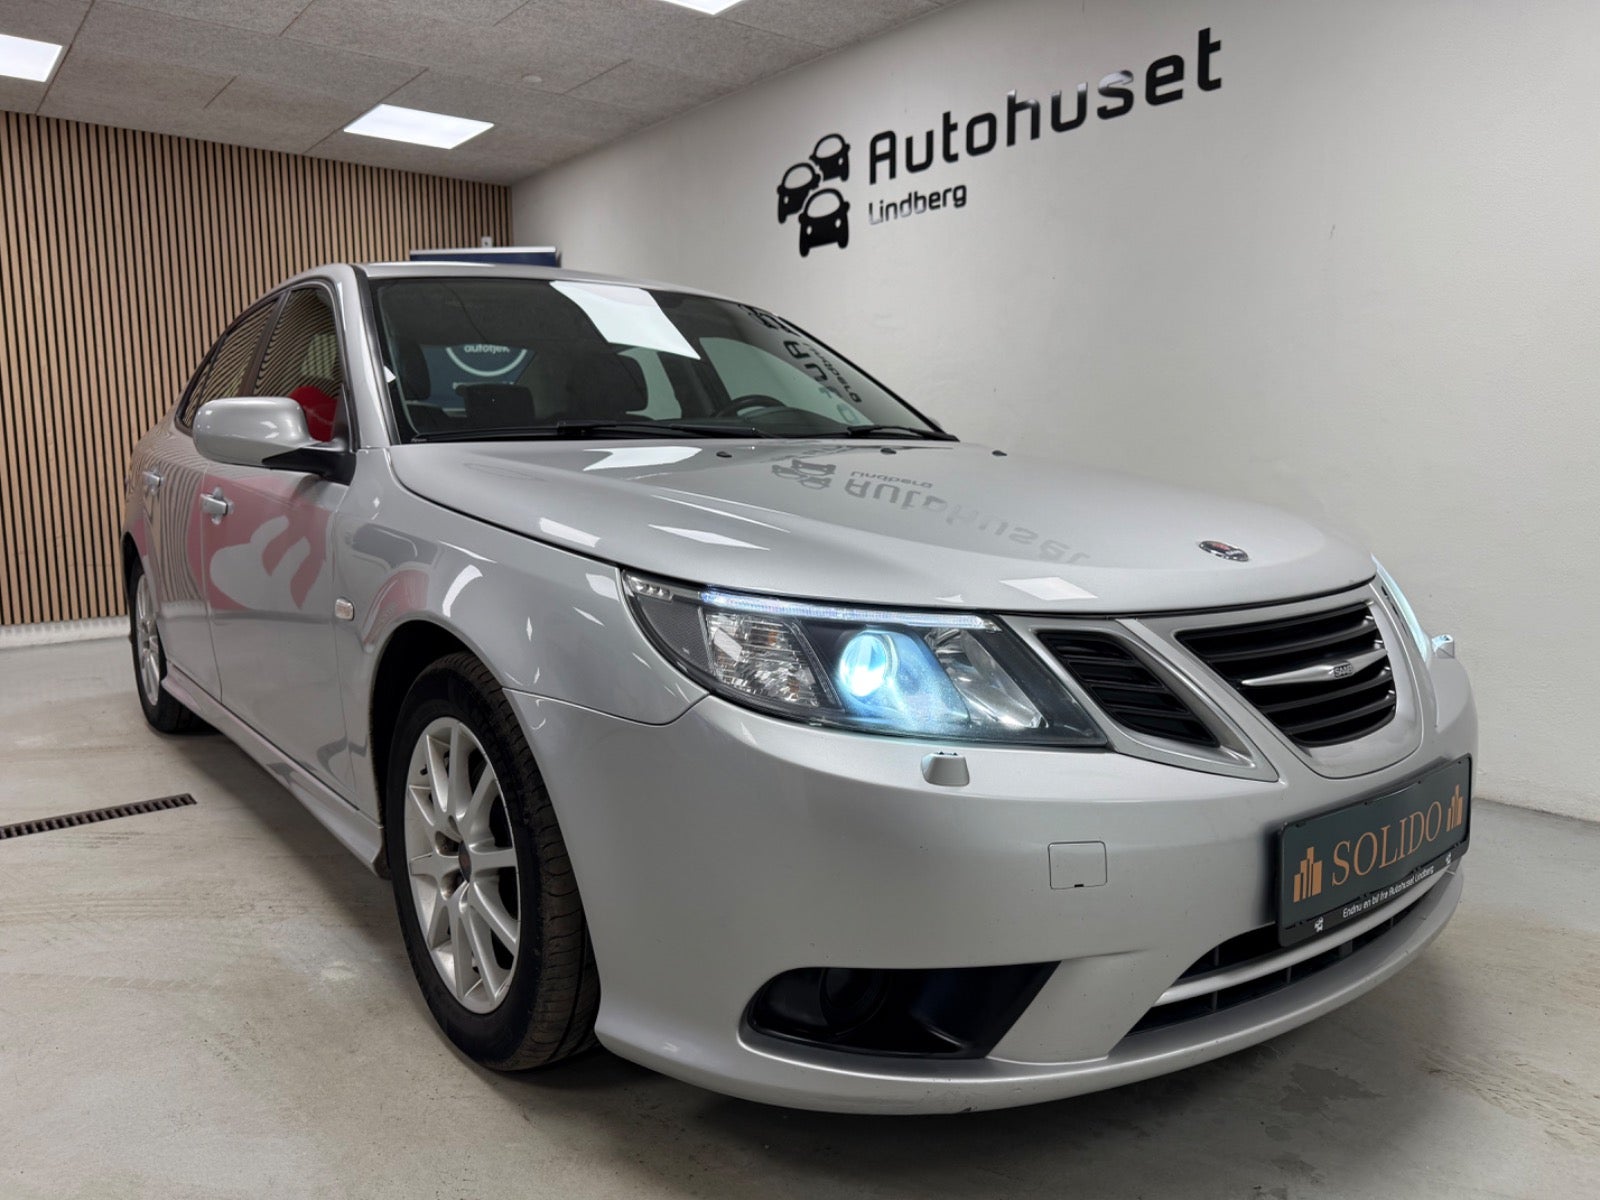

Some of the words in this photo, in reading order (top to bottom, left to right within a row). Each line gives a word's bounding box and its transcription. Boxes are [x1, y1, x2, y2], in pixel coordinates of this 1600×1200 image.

[869, 27, 1222, 185] Autohuset
[868, 184, 967, 225] Lindberg
[1331, 801, 1442, 887] SOLIDO
[1342, 904, 1362, 918] Endnu
